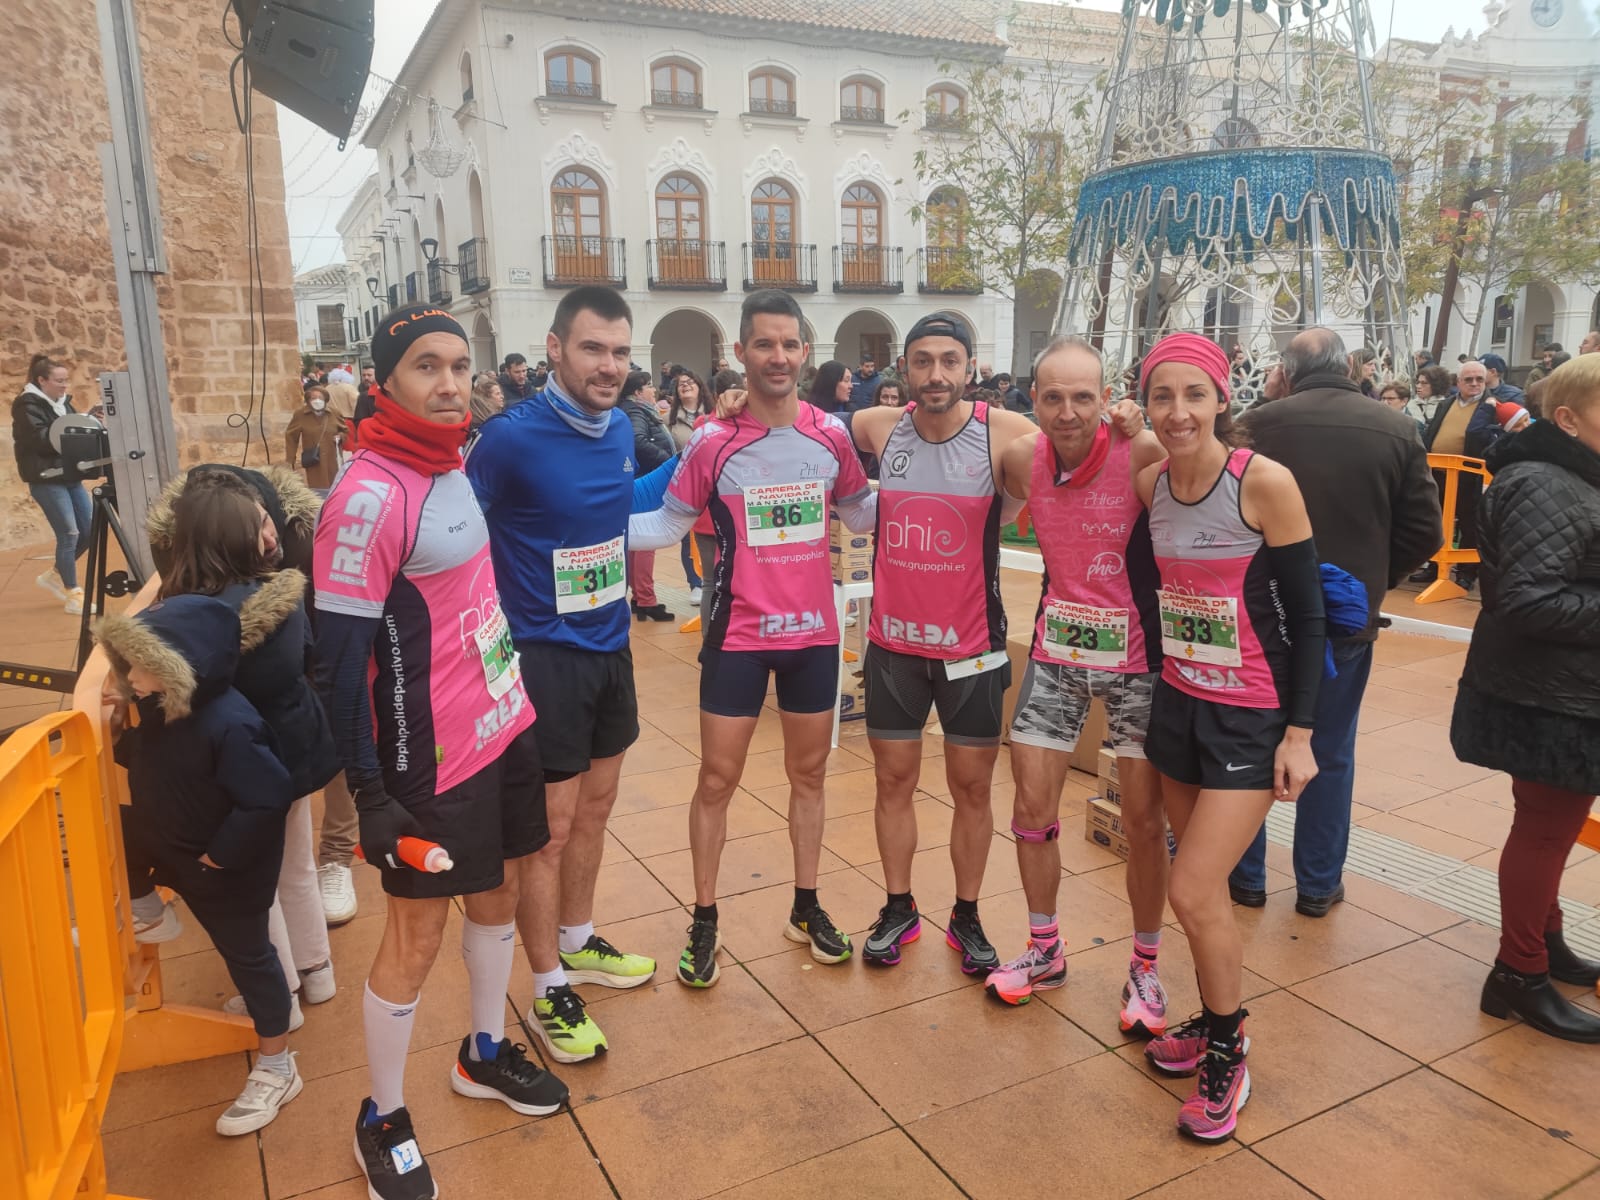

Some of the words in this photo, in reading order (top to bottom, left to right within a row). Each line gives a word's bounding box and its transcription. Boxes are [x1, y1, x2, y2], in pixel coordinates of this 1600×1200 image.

[103, 379, 116, 416] GUIL
[749, 484, 801, 495] CARRERA
[804, 482, 818, 490] DE
[758, 490, 810, 500] NAVIDAD
[746, 494, 822, 507] MANZANARES
[771, 504, 802, 528] 86
[329, 479, 391, 588] IREDA
[560, 544, 610, 559] CARRERA
[611, 540, 620, 549] DE
[570, 549, 616, 564] NAVIDAD
[556, 552, 623, 571] MANZANARES
[887, 556, 966, 573] www.grupophi.es
[583, 564, 608, 593] 31
[1161, 593, 1209, 606] CARRERA
[1171, 600, 1219, 614] NAVIDAD
[1053, 603, 1102, 617] CARRERA
[1058, 610, 1111, 623] NAVIDAD
[1161, 605, 1235, 622] MANZANARES
[758, 608, 825, 638] IREDA
[882, 614, 960, 646] IREDA
[1047, 613, 1126, 629] MANZANARES
[1066, 624, 1098, 650] 23
[1181, 616, 1213, 645] 33
[385, 614, 411, 772] gpphipolideportivo.com
